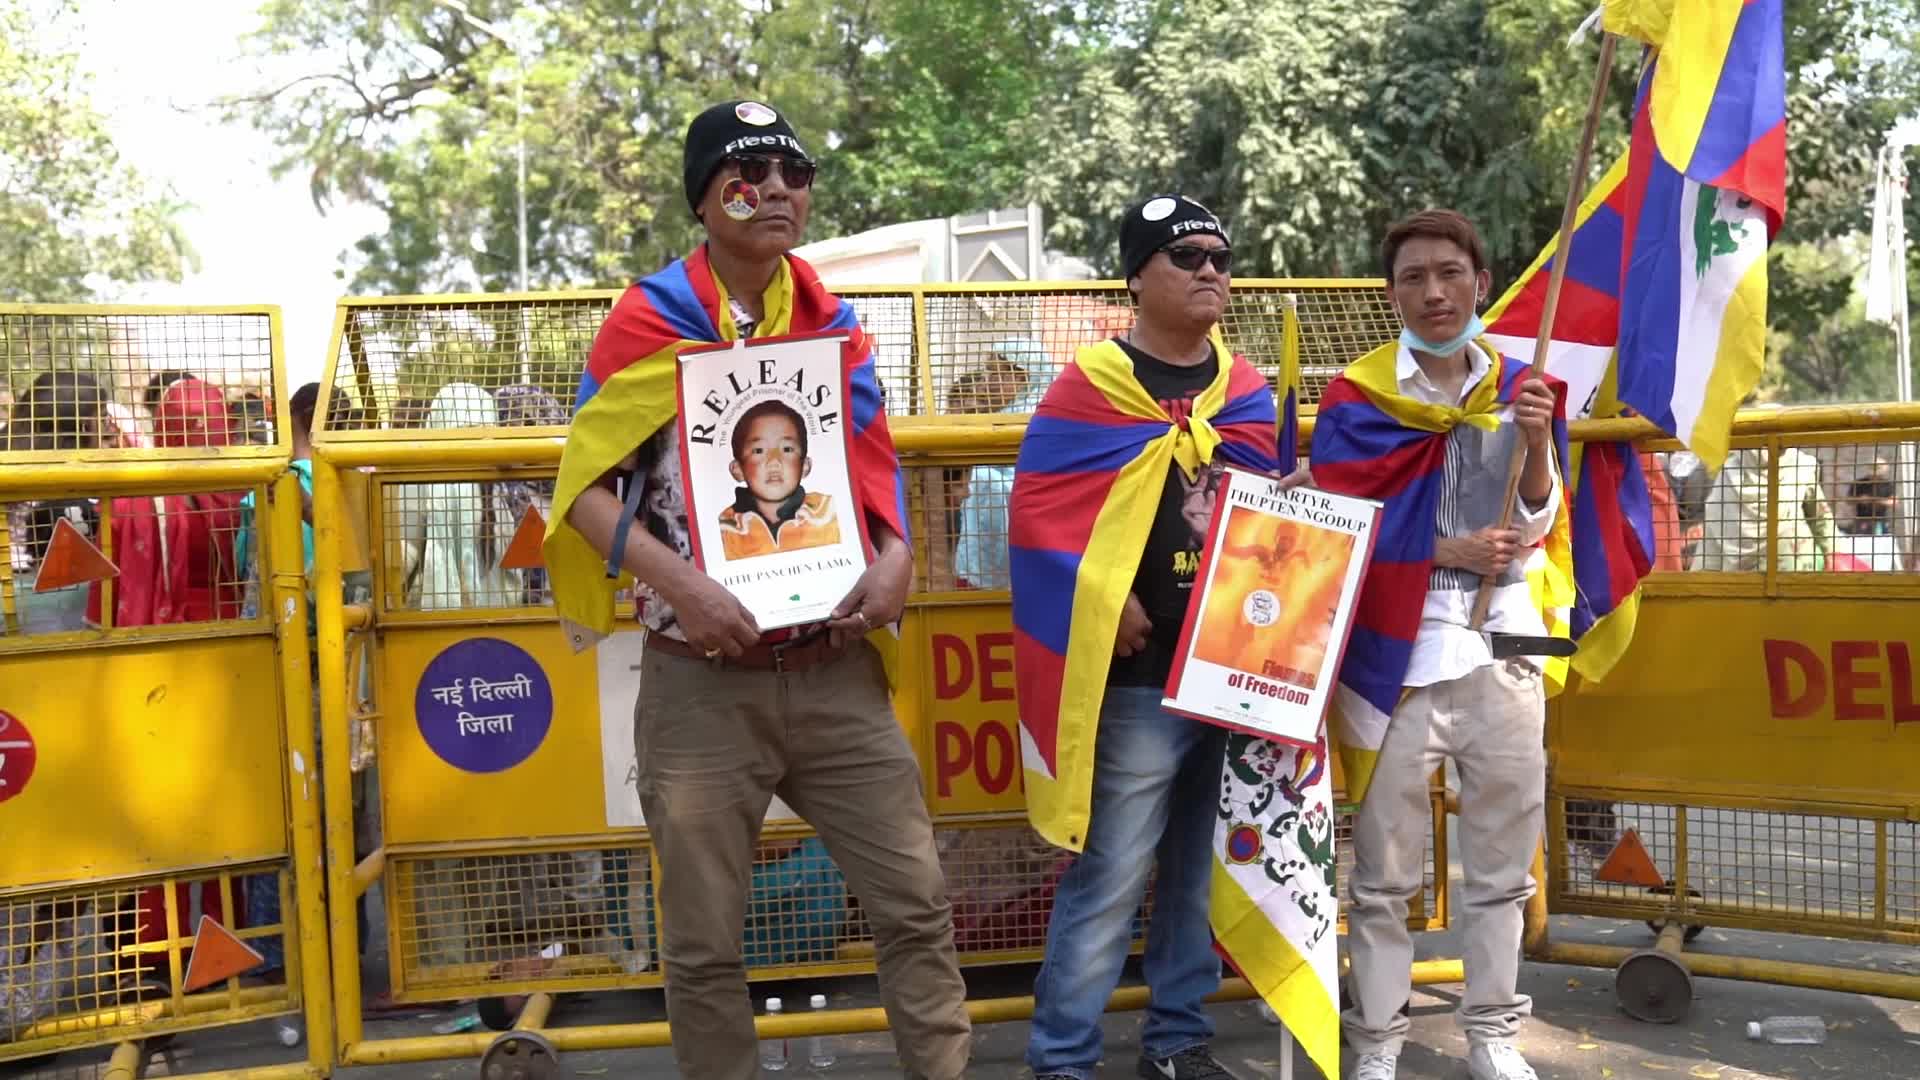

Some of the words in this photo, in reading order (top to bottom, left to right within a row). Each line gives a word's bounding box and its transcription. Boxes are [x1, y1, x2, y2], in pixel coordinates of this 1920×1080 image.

[691, 359, 839, 445] RELEASE
[752, 388, 786, 396] Prisoner
[1231, 489, 1297, 516] THUPTEN
[1302, 508, 1367, 532] NGODUP
[817, 558, 852, 570] LAMA
[432, 678, 465, 707] नई
[469, 673, 533, 703] दिल्ली
[1228, 673, 1243, 689] of
[1245, 676, 1310, 706] Freedom
[456, 711, 514, 736] जिला
[934, 720, 1024, 798] PO
